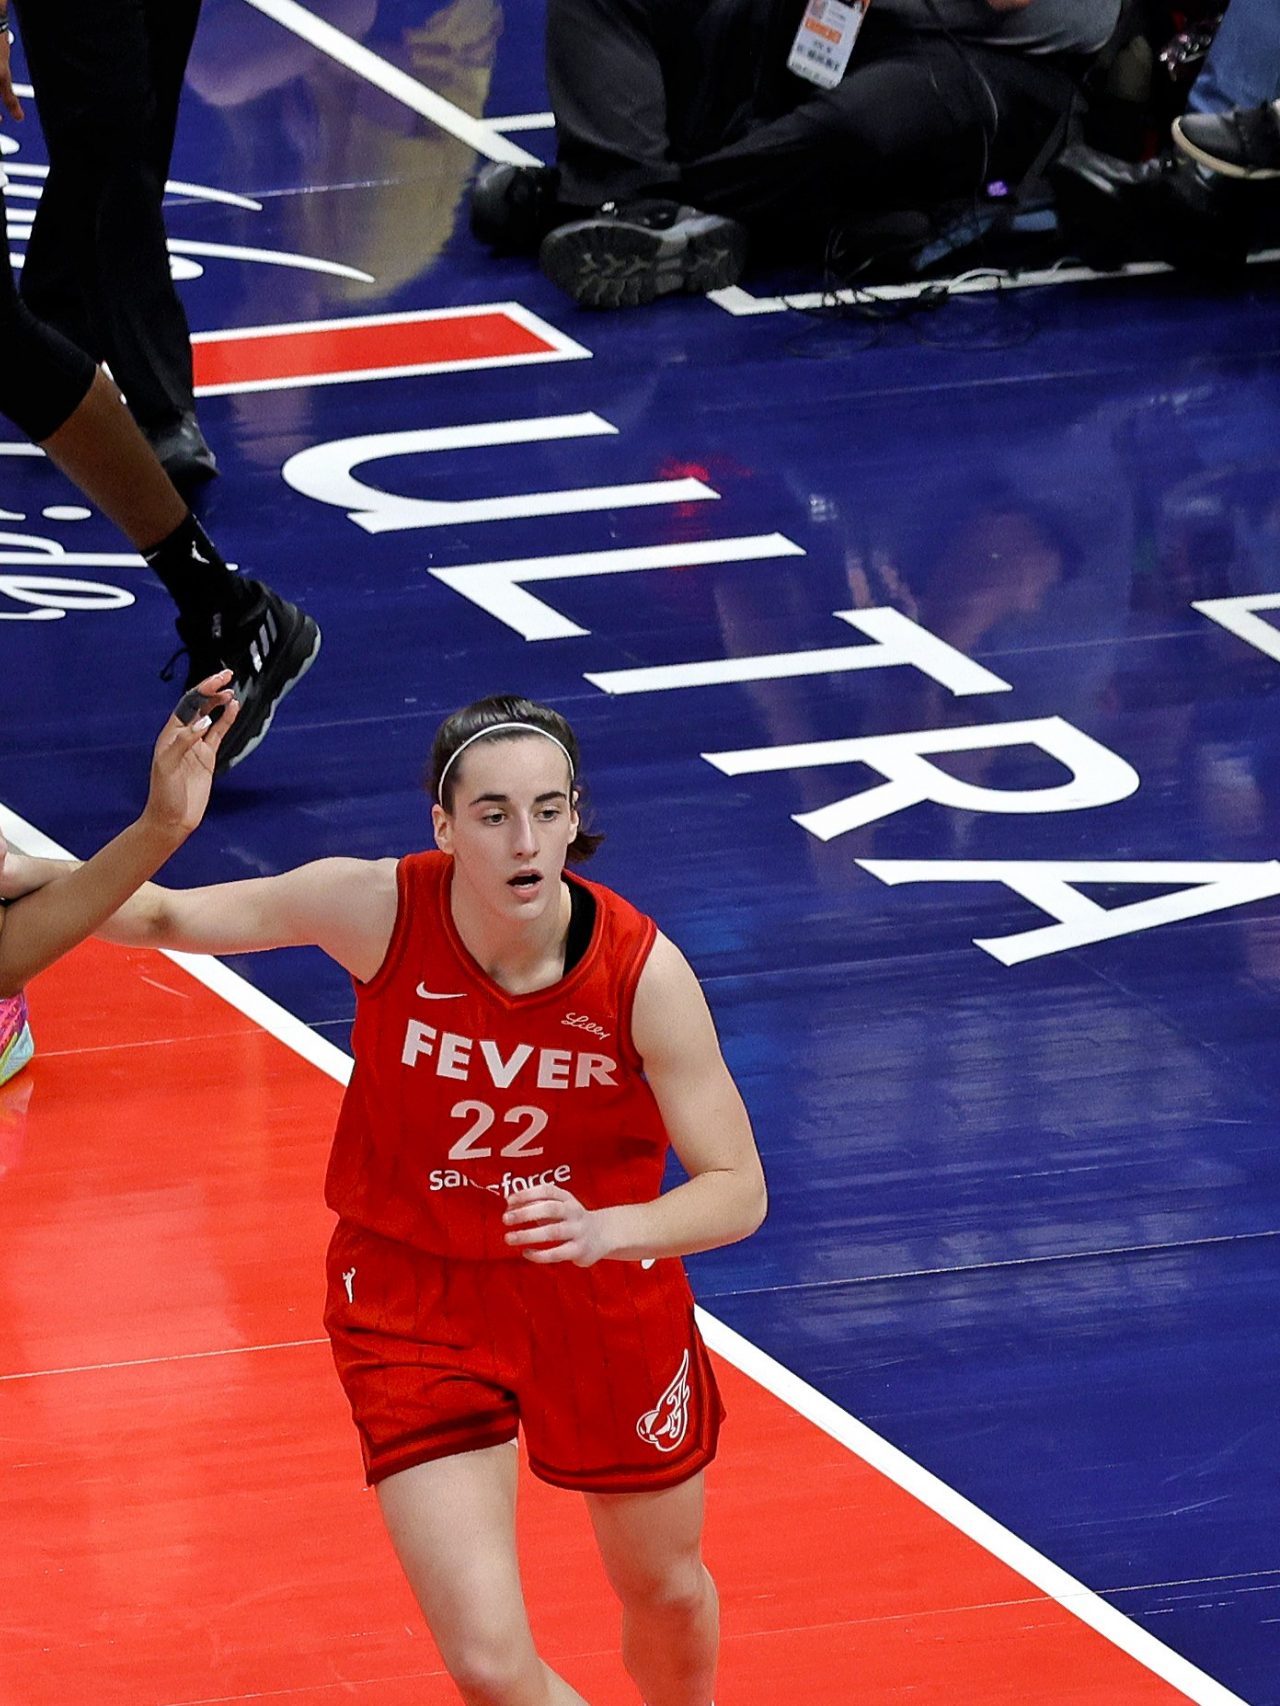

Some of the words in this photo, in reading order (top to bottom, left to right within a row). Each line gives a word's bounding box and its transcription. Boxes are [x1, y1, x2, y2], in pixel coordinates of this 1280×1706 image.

[281, 411, 1280, 966] ULTRA
[401, 1018, 619, 1090] FEVER
[561, 1012, 610, 1040] Lilly
[448, 1100, 548, 1160] 22
